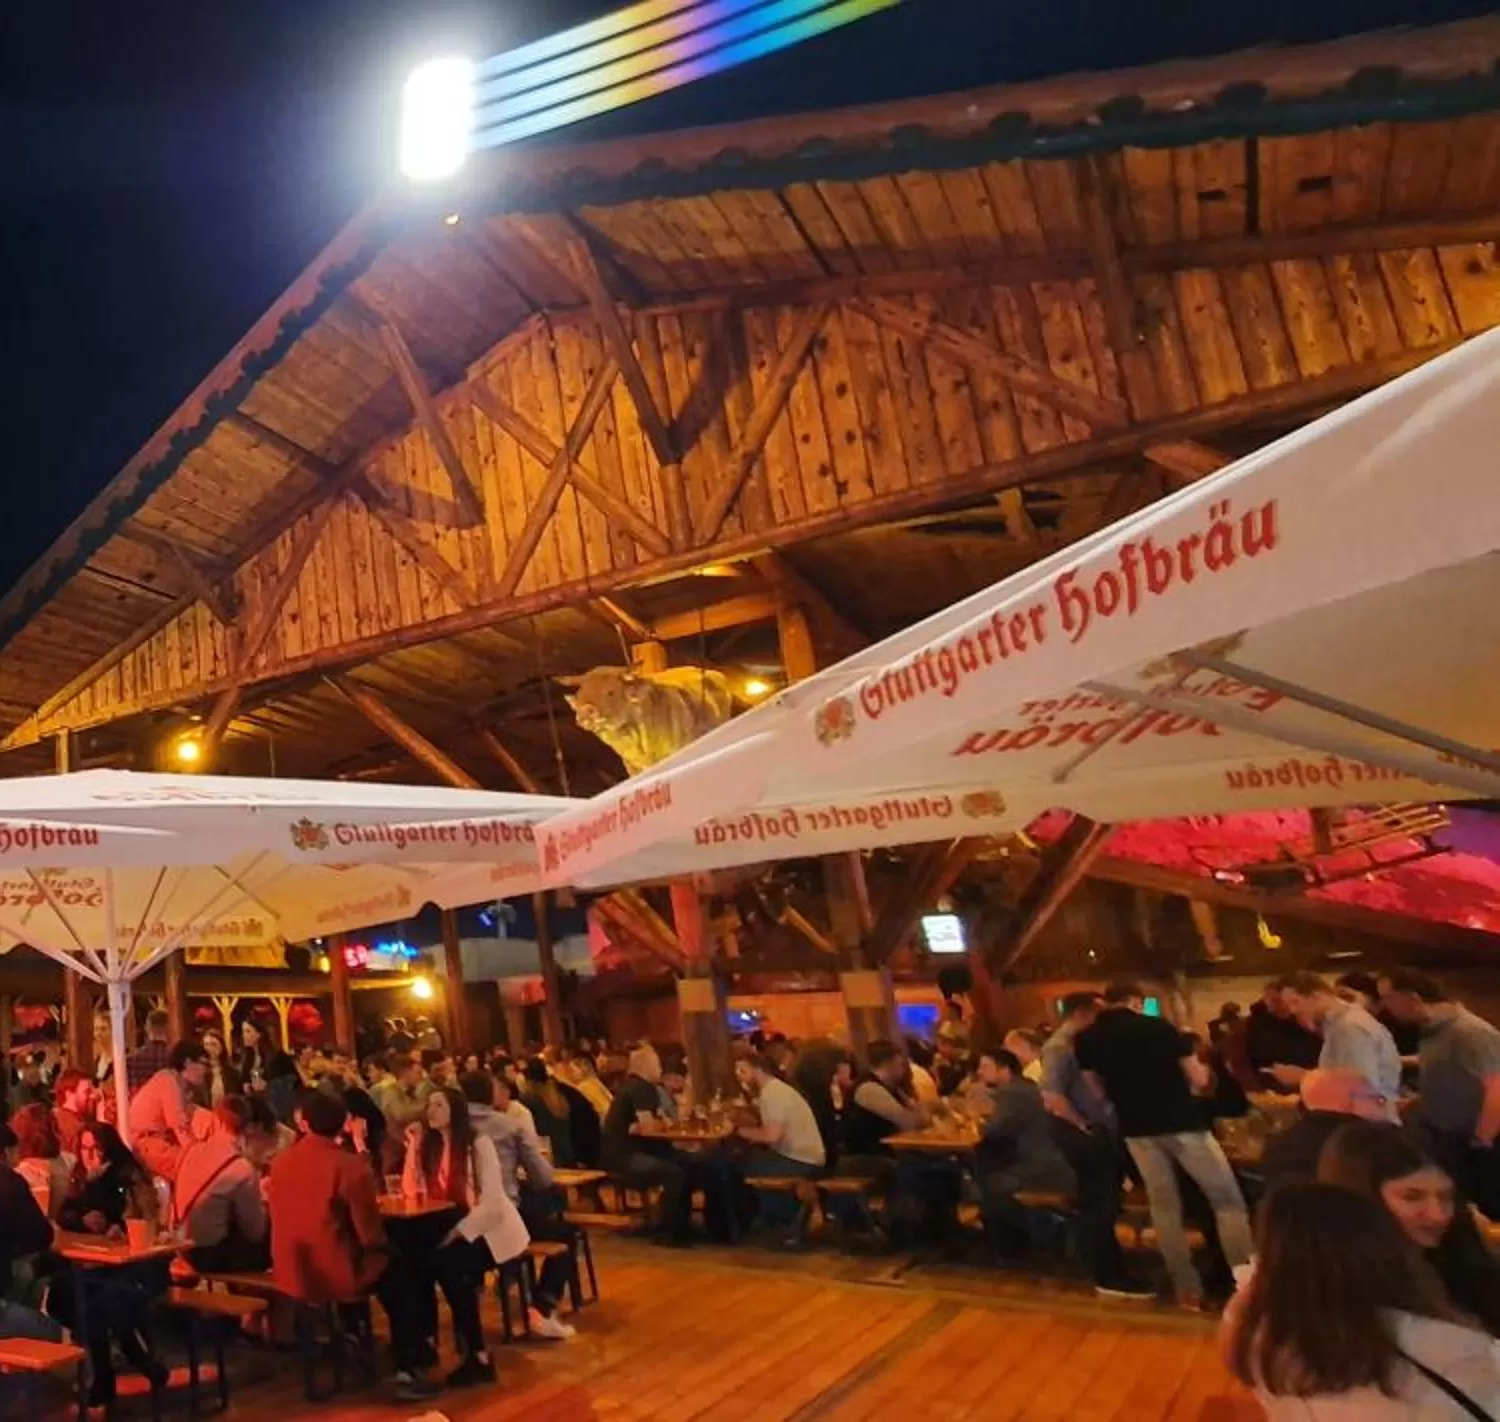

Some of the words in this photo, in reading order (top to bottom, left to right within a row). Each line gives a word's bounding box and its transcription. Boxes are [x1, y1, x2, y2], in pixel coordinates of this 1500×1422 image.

[860, 603, 1047, 720] Stuttgarter
[334, 821, 457, 849] Stuttgarter
[463, 820, 535, 846] Hofbrä
